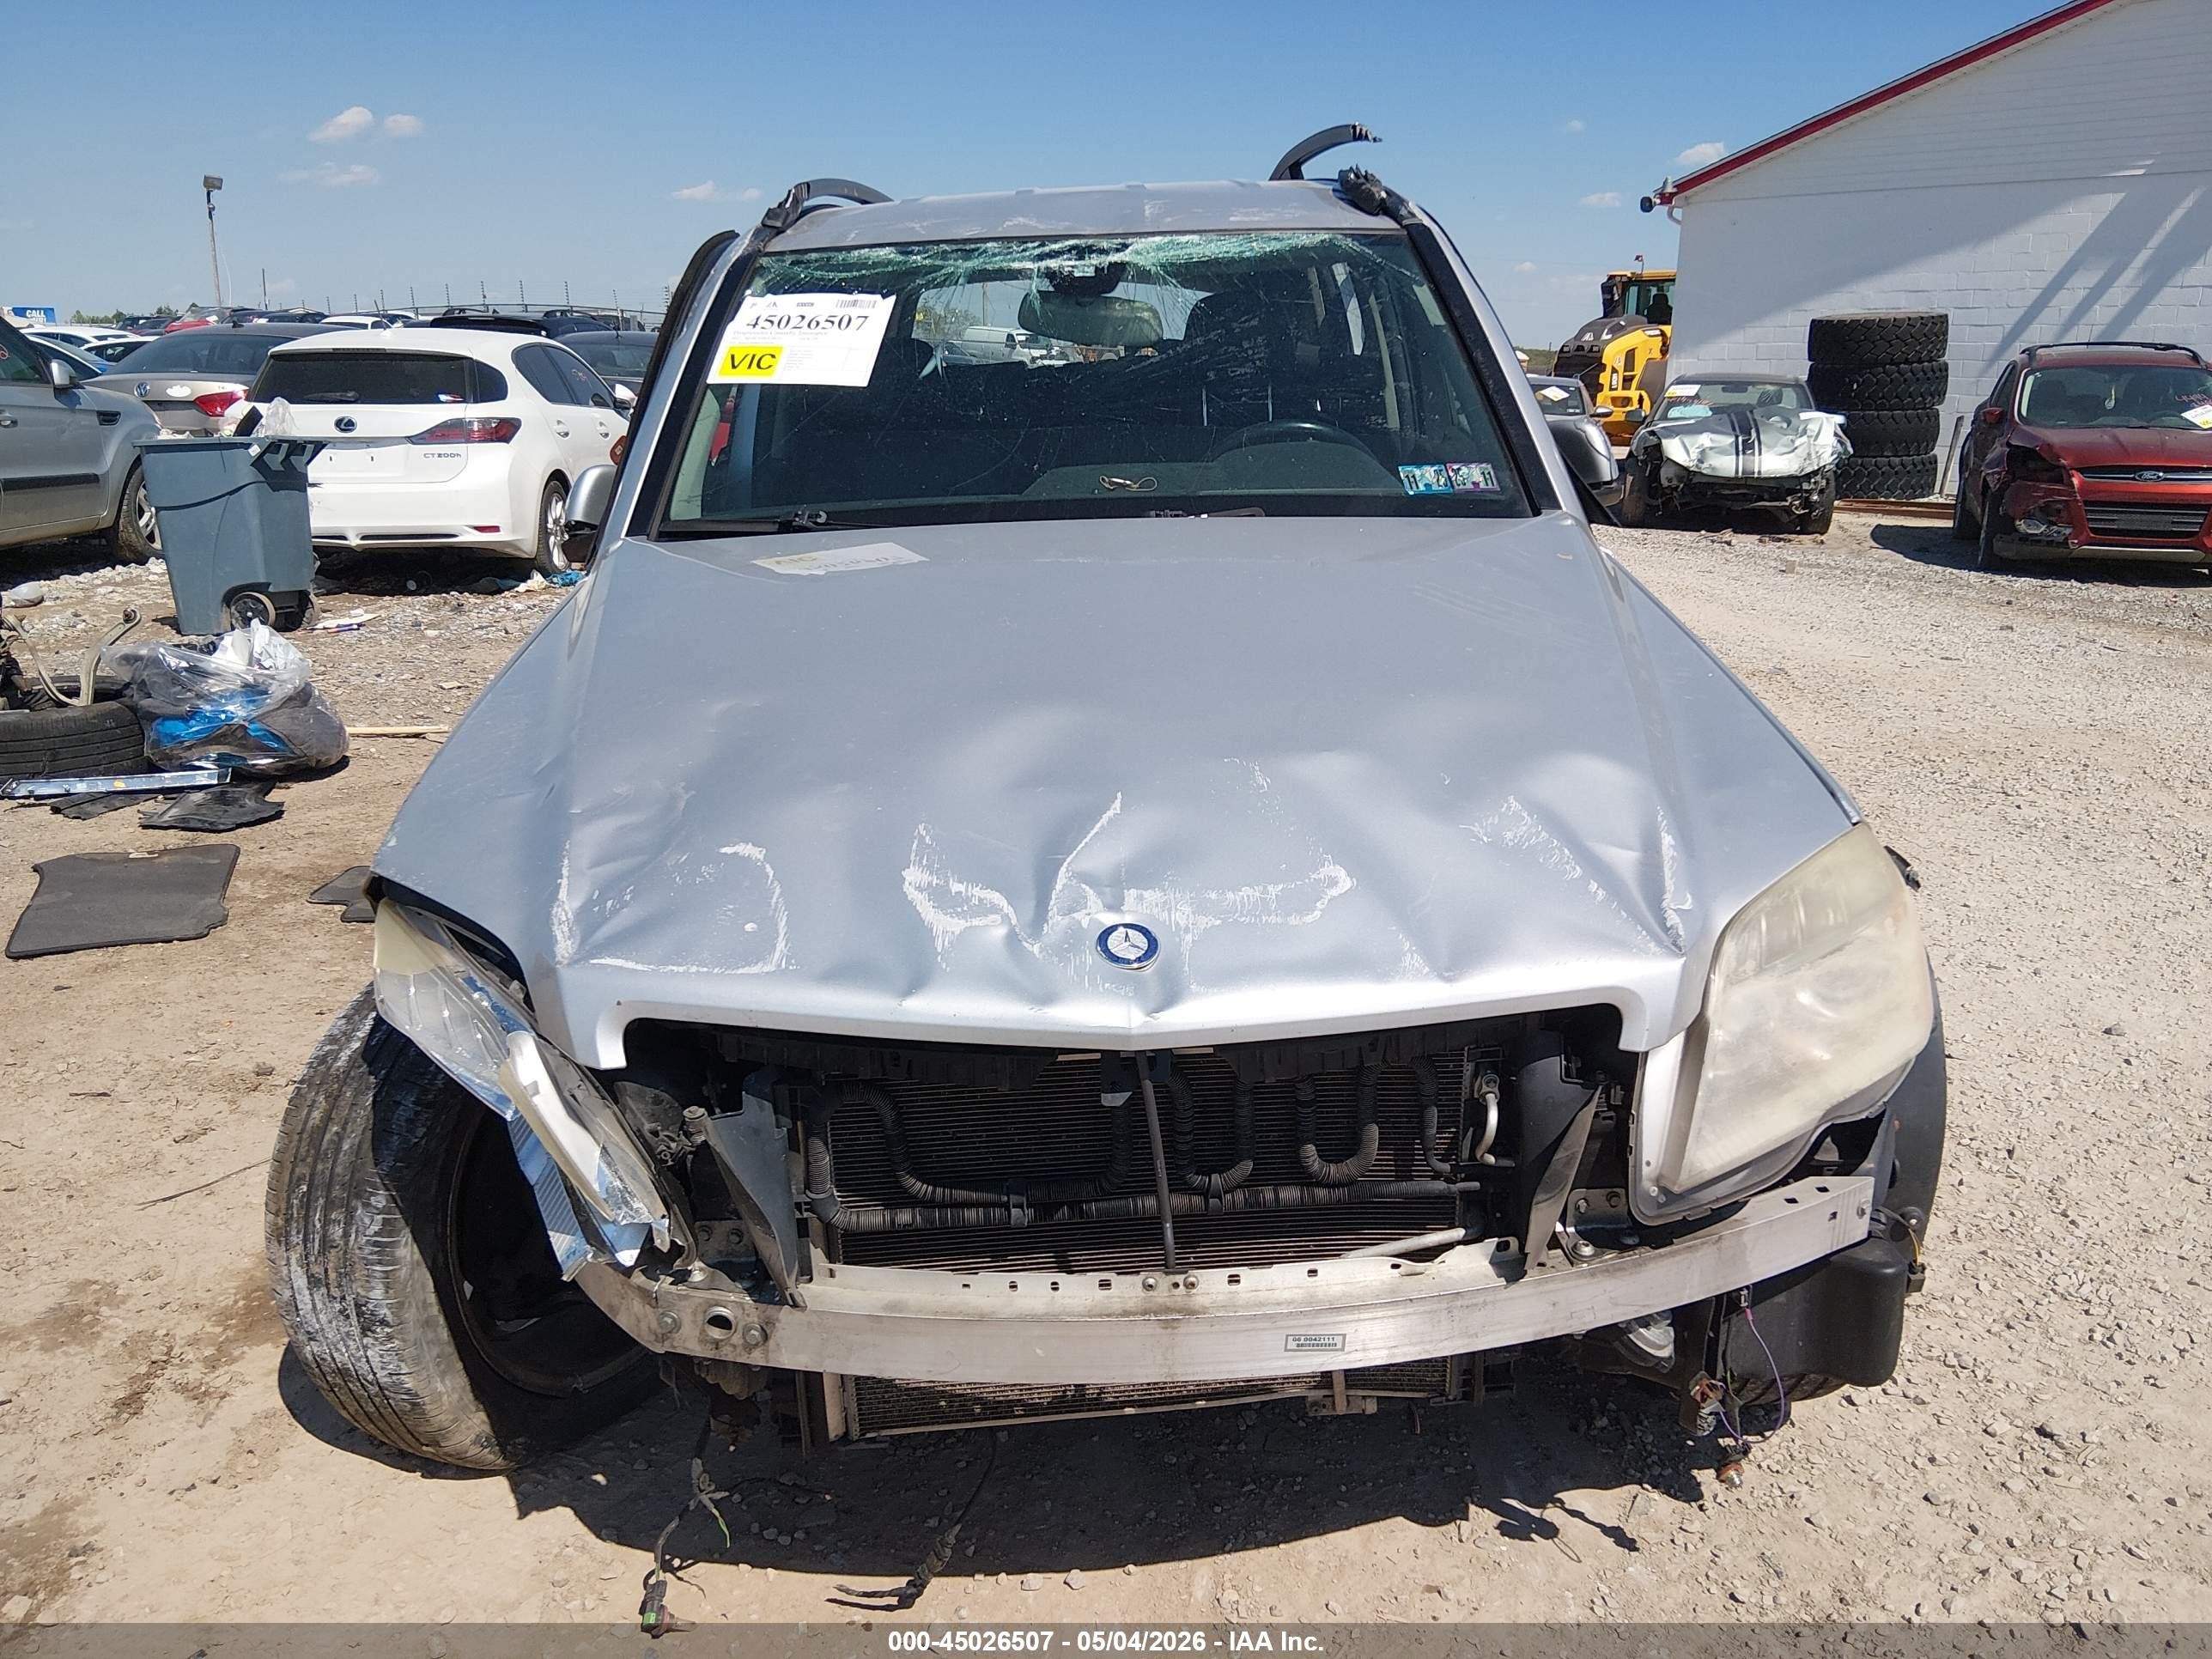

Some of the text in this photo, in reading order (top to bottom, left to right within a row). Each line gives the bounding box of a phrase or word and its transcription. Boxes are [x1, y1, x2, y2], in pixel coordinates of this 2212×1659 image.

[26, 309, 46, 318] CALL
[746, 313, 870, 331] 45026507
[730, 353, 776, 370] VIC
[1404, 474, 1419, 490] 11
[1480, 471, 1495, 487] 11
